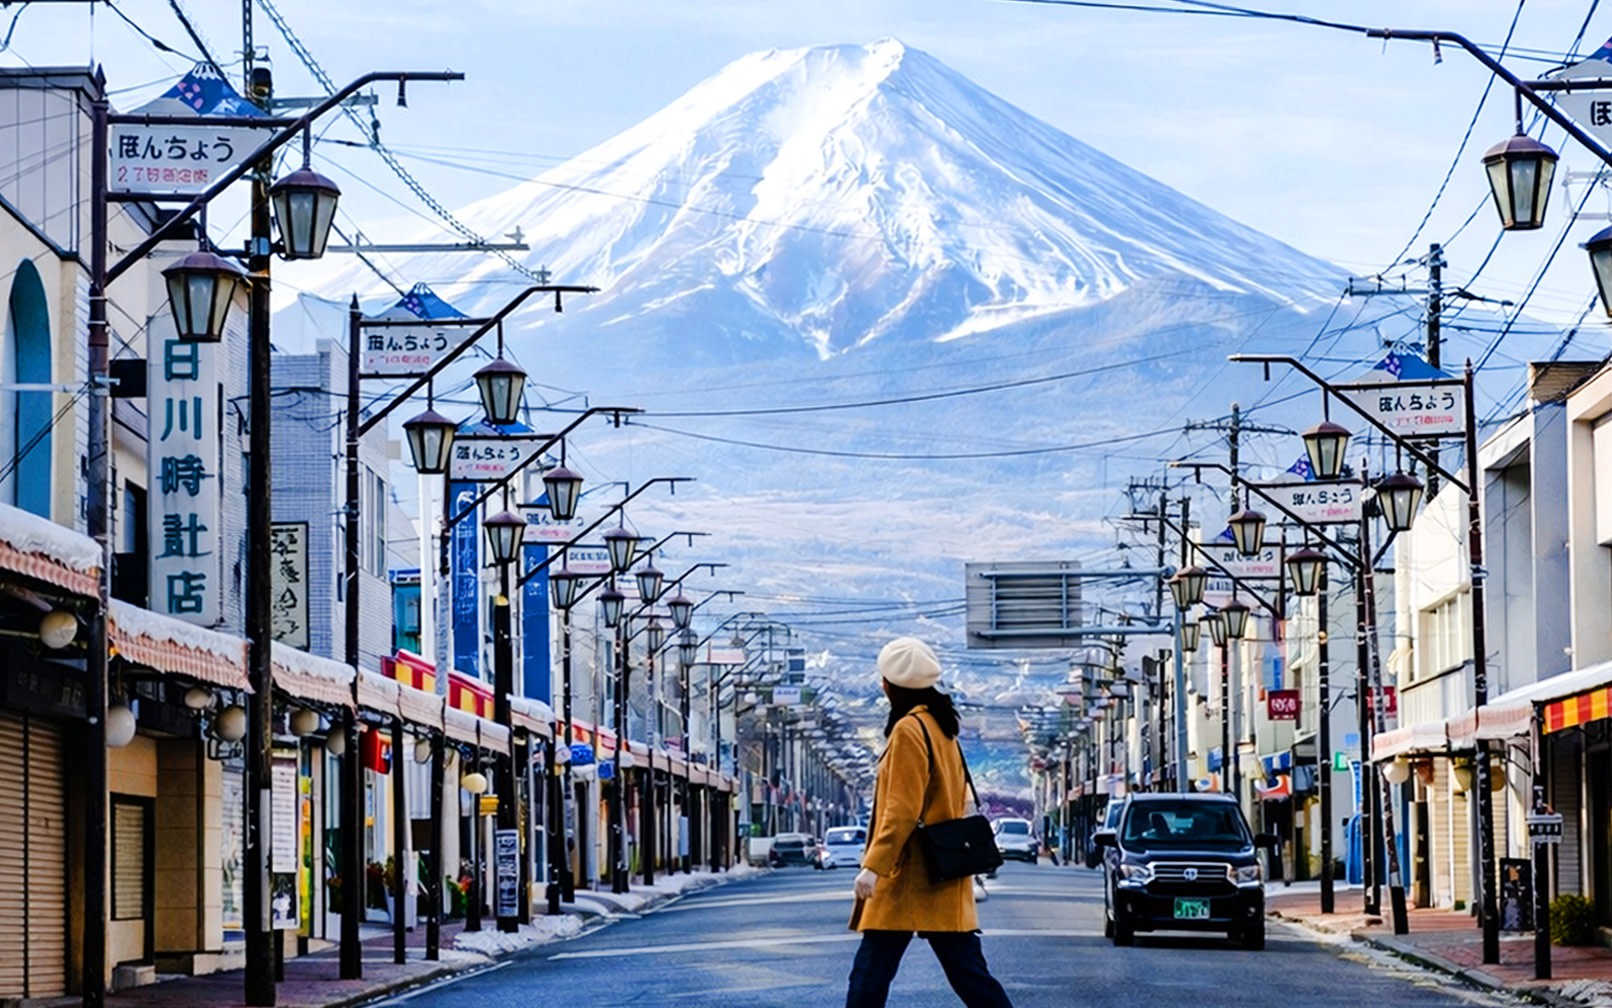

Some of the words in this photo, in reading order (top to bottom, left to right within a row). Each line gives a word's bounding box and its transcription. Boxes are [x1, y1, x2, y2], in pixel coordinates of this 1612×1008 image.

[1591, 101, 1612, 126] ほ
[156, 339, 214, 614] 日川時計店
